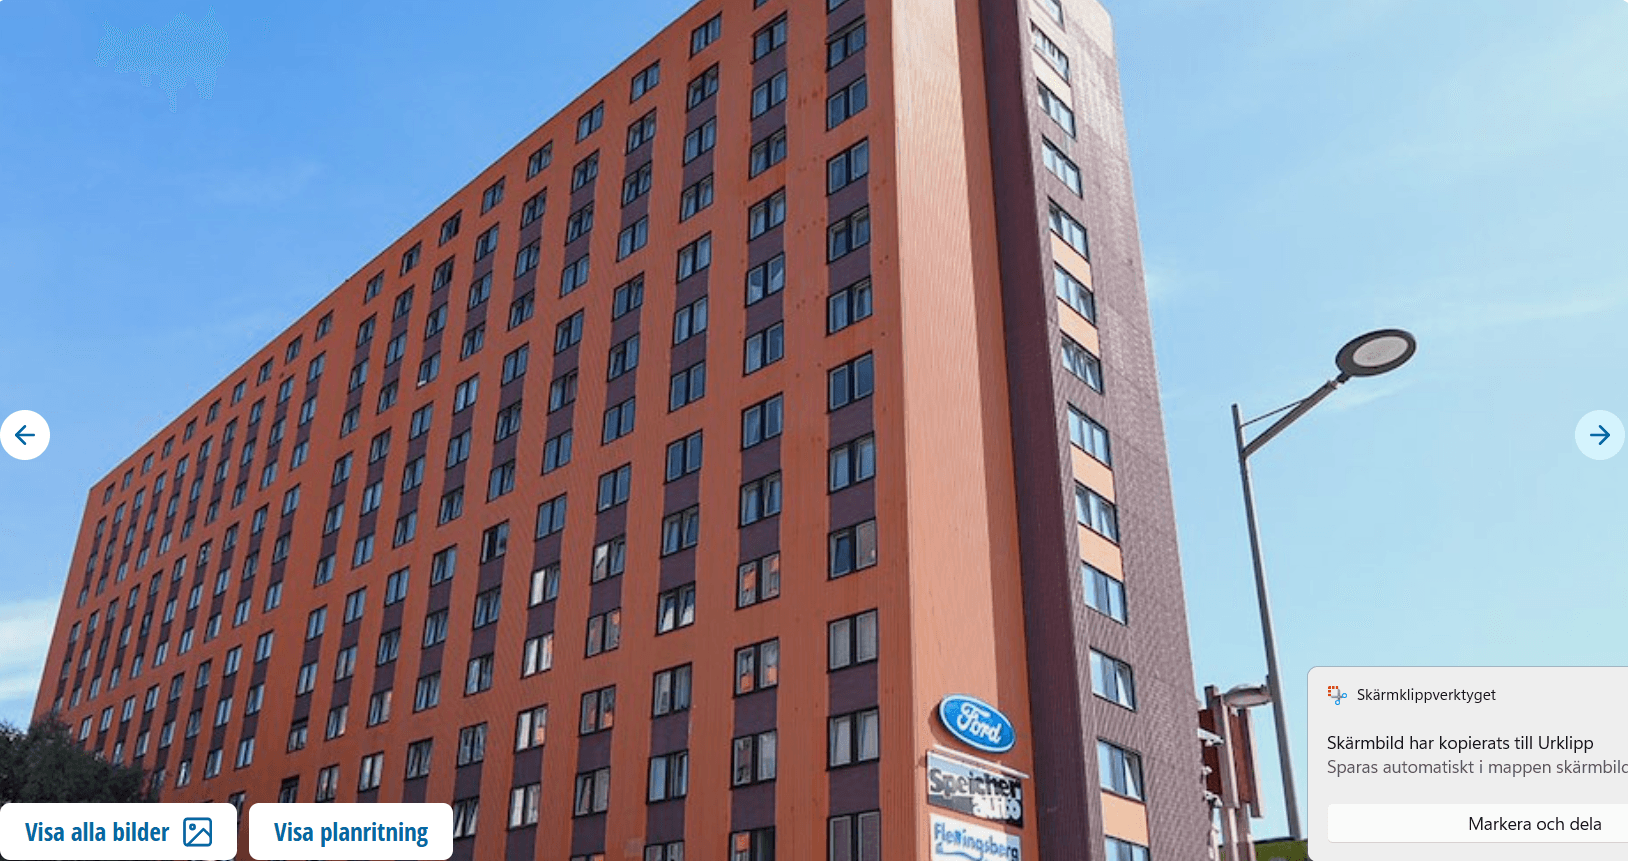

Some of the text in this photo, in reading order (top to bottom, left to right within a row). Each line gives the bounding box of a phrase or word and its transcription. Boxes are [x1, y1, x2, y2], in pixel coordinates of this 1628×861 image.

[956, 702, 1002, 743] Ford
[930, 768, 1021, 799] Speicher
[971, 795, 1021, 820] auto
